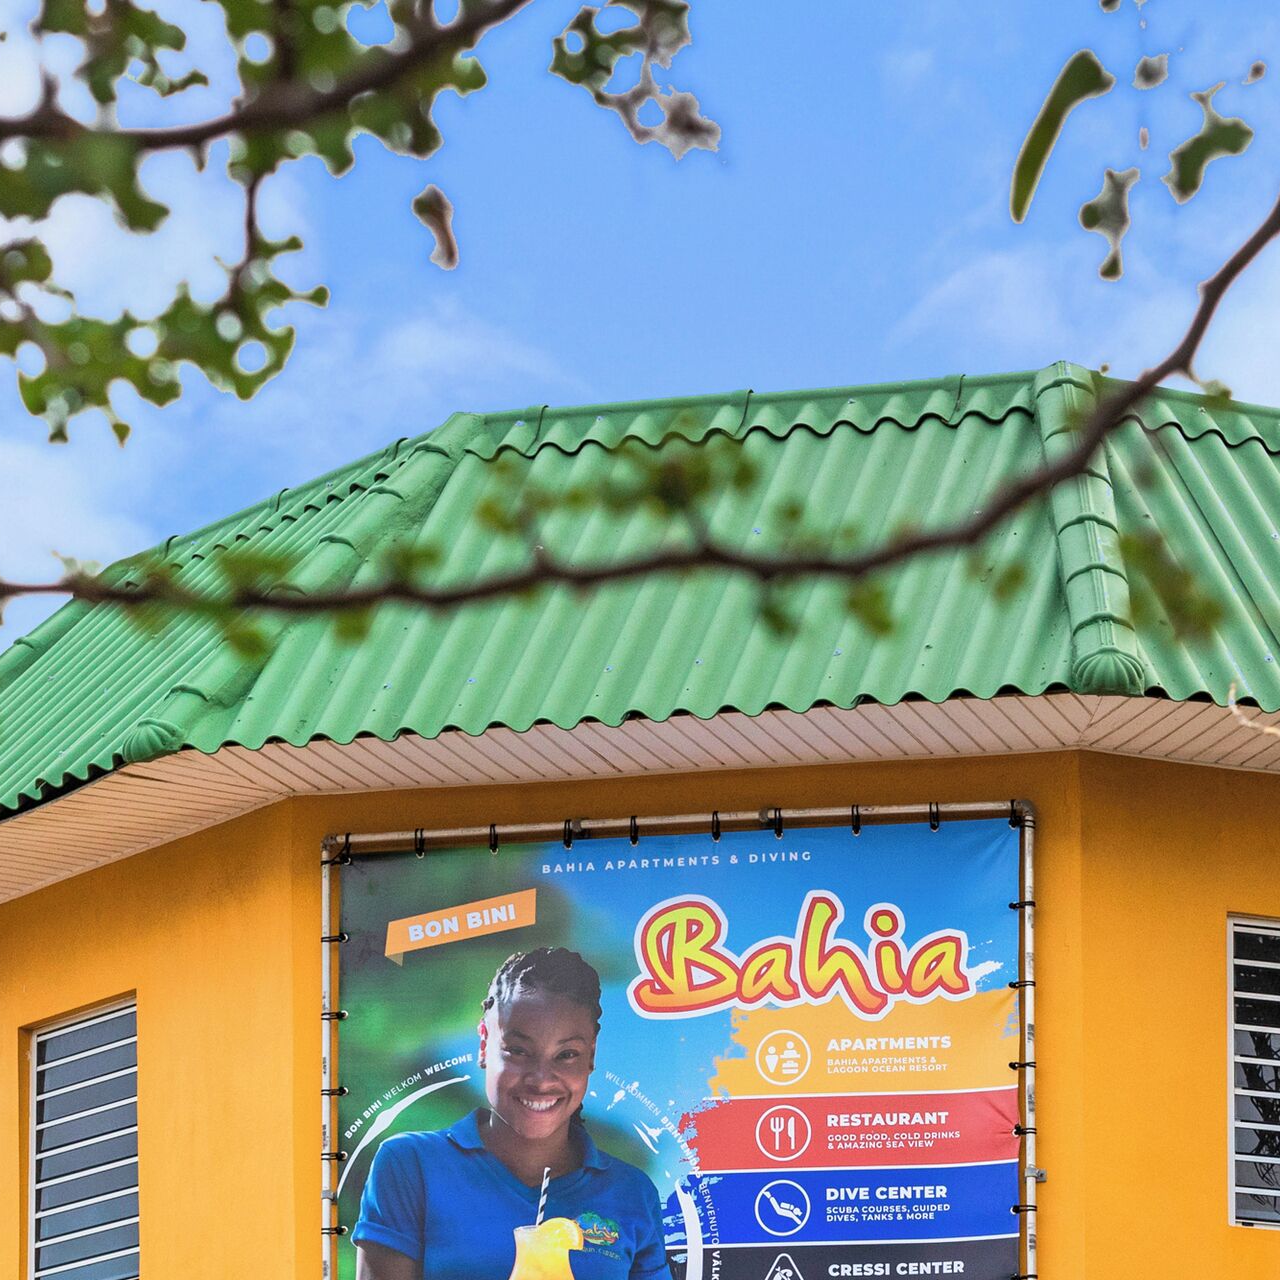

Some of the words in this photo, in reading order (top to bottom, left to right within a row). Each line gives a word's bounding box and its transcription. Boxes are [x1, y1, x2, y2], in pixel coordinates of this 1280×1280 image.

[542, 862, 595, 874] BAHIA
[605, 854, 720, 870] APARTMENTS
[729, 855, 738, 864] &
[749, 851, 812, 864] DIVING
[408, 915, 459, 942] BON
[466, 903, 516, 929] BINI
[633, 896, 970, 1015] Bahia
[827, 1036, 951, 1051] APARTMENTS
[827, 1058, 858, 1066] BAHIA
[861, 1057, 927, 1065] APARTMENTS
[827, 1065, 867, 1074] LAGOON
[909, 1063, 947, 1072] RESORT
[344, 1118, 364, 1139] BON
[362, 1100, 382, 1119] BINI
[382, 1073, 422, 1101] WELKOM
[424, 1054, 473, 1076] WELCOME
[827, 1112, 949, 1127] RESTAURANT
[838, 1141, 882, 1149] AMAZING
[886, 1140, 904, 1148] SEA
[907, 1139, 934, 1147] VIEW
[860, 1133, 890, 1142] FOOD,
[893, 1132, 920, 1140] COLD
[924, 1131, 960, 1139] DRINKS
[605, 1071, 661, 1116] WILLKOMMEN
[700, 1182, 720, 1246] BENVENUTO
[826, 1187, 869, 1200] DIVE
[876, 1185, 947, 1199] CENTER
[826, 1206, 859, 1214] SCUBA
[862, 1205, 910, 1213] COURSES,
[913, 1204, 950, 1212] GUIDED
[827, 1214, 859, 1223] DIVES,
[906, 1212, 934, 1220] MORE
[582, 1223, 619, 1239] ahia
[828, 1264, 890, 1277] CRESSI
[896, 1261, 964, 1275] CENTER
